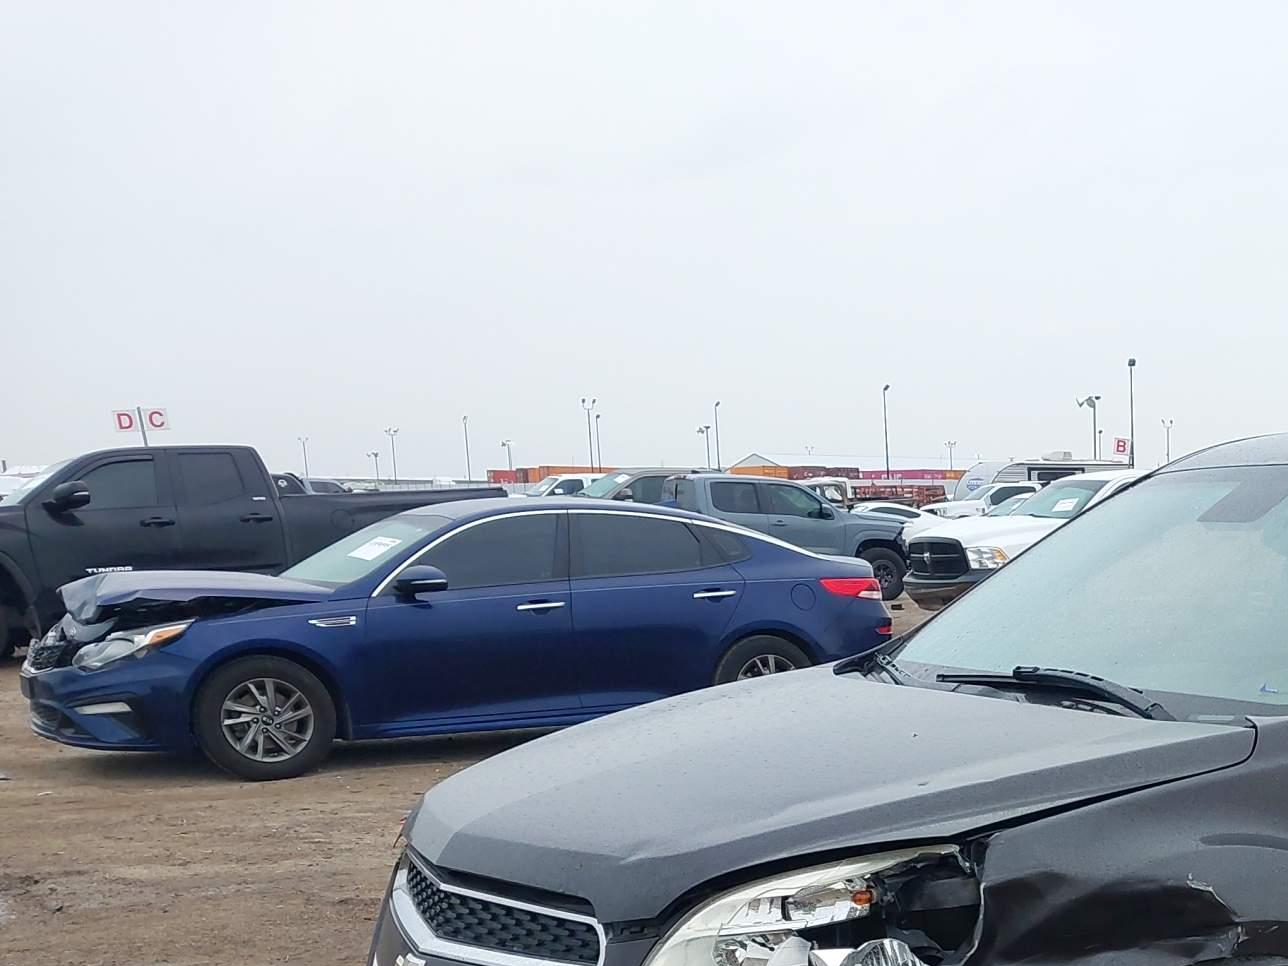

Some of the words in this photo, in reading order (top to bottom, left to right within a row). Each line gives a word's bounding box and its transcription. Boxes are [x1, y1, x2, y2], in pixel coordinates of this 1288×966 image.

[117, 413, 133, 429] D
[149, 411, 164, 427] C
[1116, 439, 1126, 452] B
